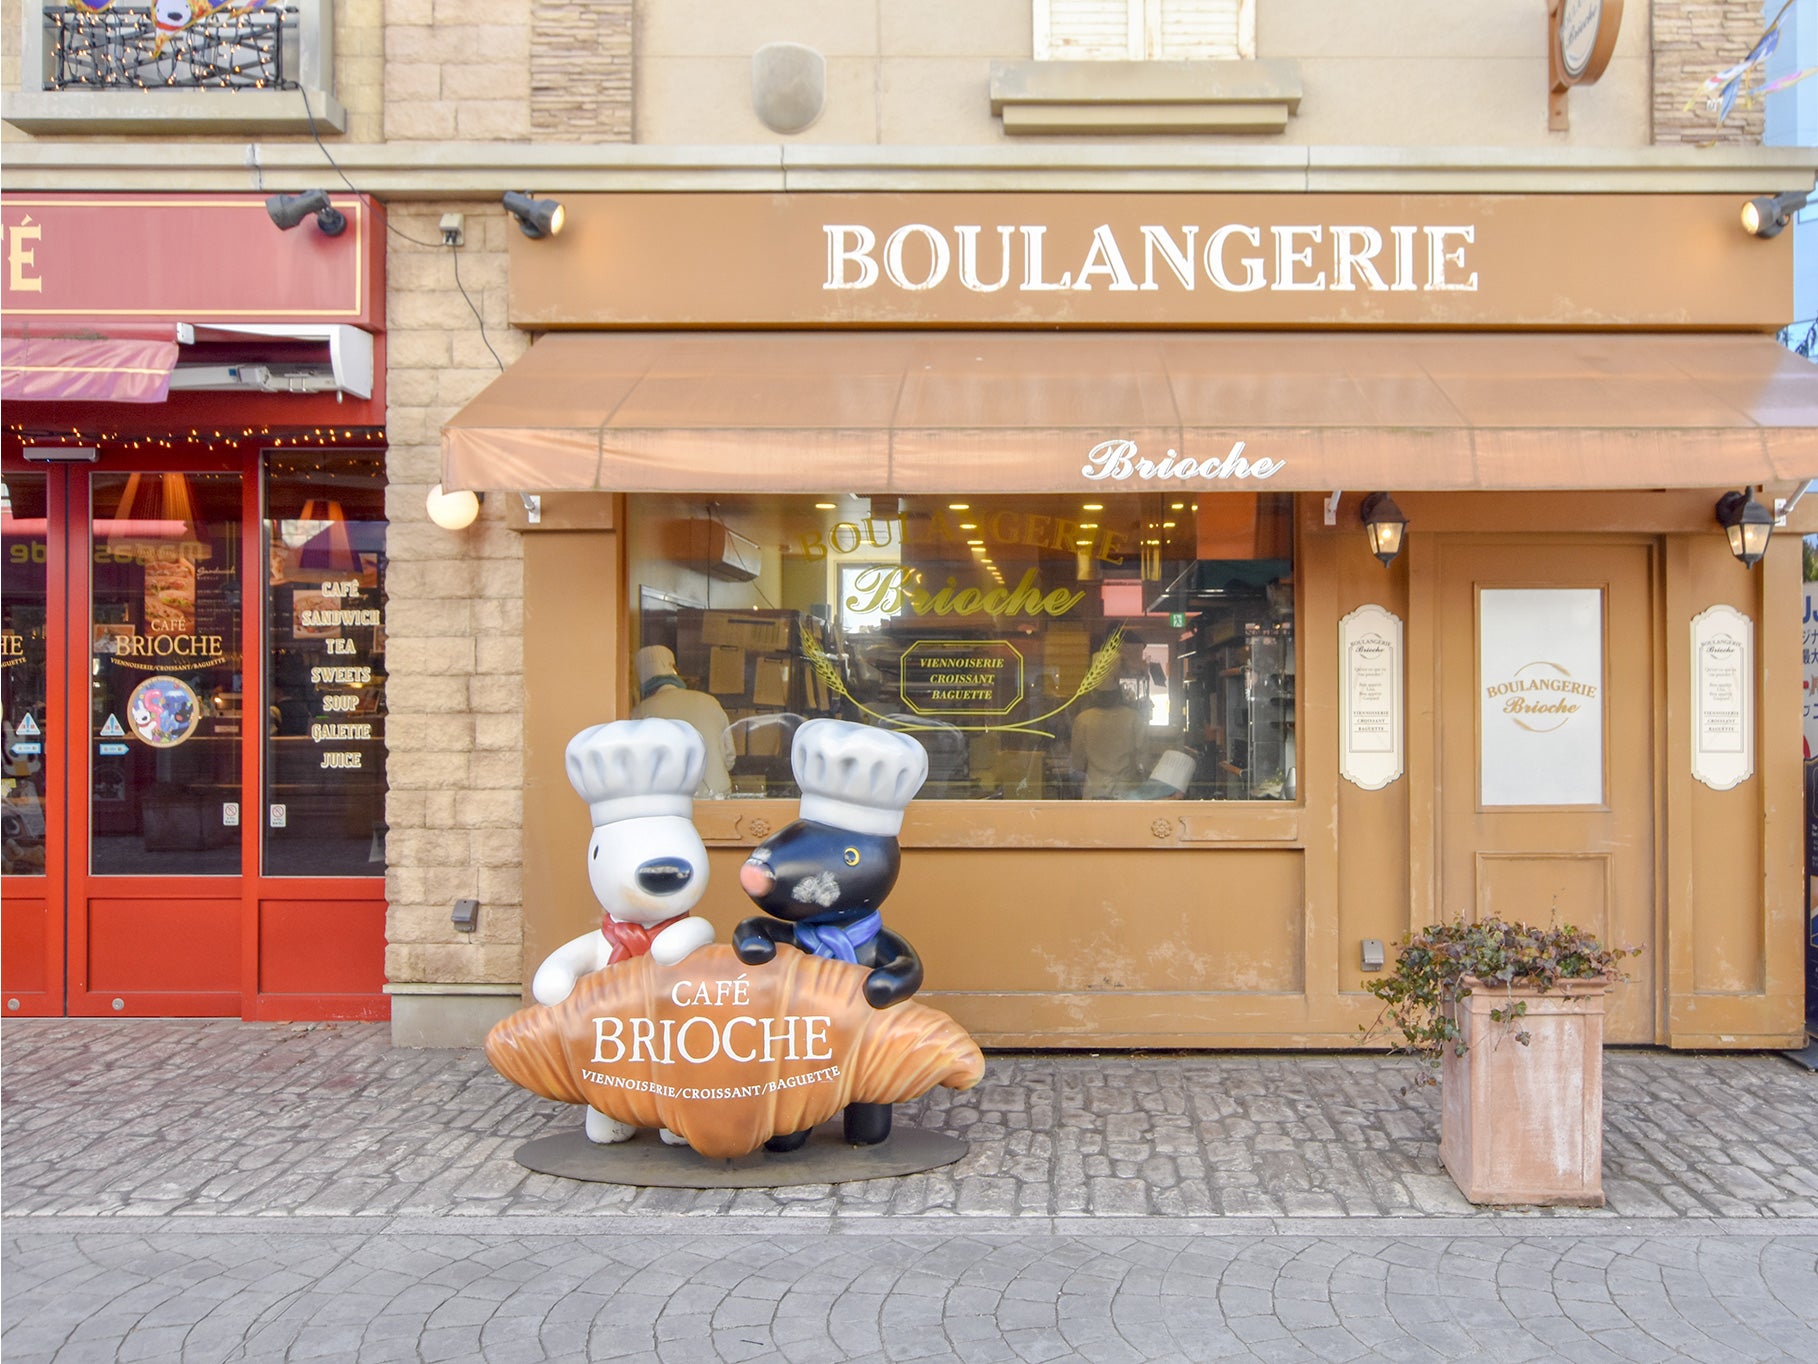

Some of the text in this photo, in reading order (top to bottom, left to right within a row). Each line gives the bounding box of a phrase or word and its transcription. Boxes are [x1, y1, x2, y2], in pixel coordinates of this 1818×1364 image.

[1, 213, 42, 293] É
[823, 224, 1479, 293] BOULANGERIE
[1081, 439, 1286, 482] Brioche
[798, 509, 1129, 566] BOULANGERIE
[321, 578, 360, 598] CAFÉ
[845, 563, 1086, 617] Brioche
[151, 616, 186, 632] CAFÉ
[301, 609, 381, 626] SANDWICH
[115, 634, 223, 656] BRIOCHE
[325, 638, 357, 655] TEA
[919, 658, 1005, 669] VIENNOISERIE
[310, 666, 371, 683] SWEETS
[929, 674, 995, 685] CROISSANT
[931, 690, 993, 700] BAGUETTE
[1486, 679, 1597, 698] BOULANGERIE
[322, 695, 360, 711] SOUP
[1503, 696, 1581, 713] Brioche
[311, 723, 372, 743] GALETTE
[320, 752, 362, 769] JUICE
[671, 973, 750, 1007] CAFÉ
[591, 1016, 833, 1064] BRIOCHE
